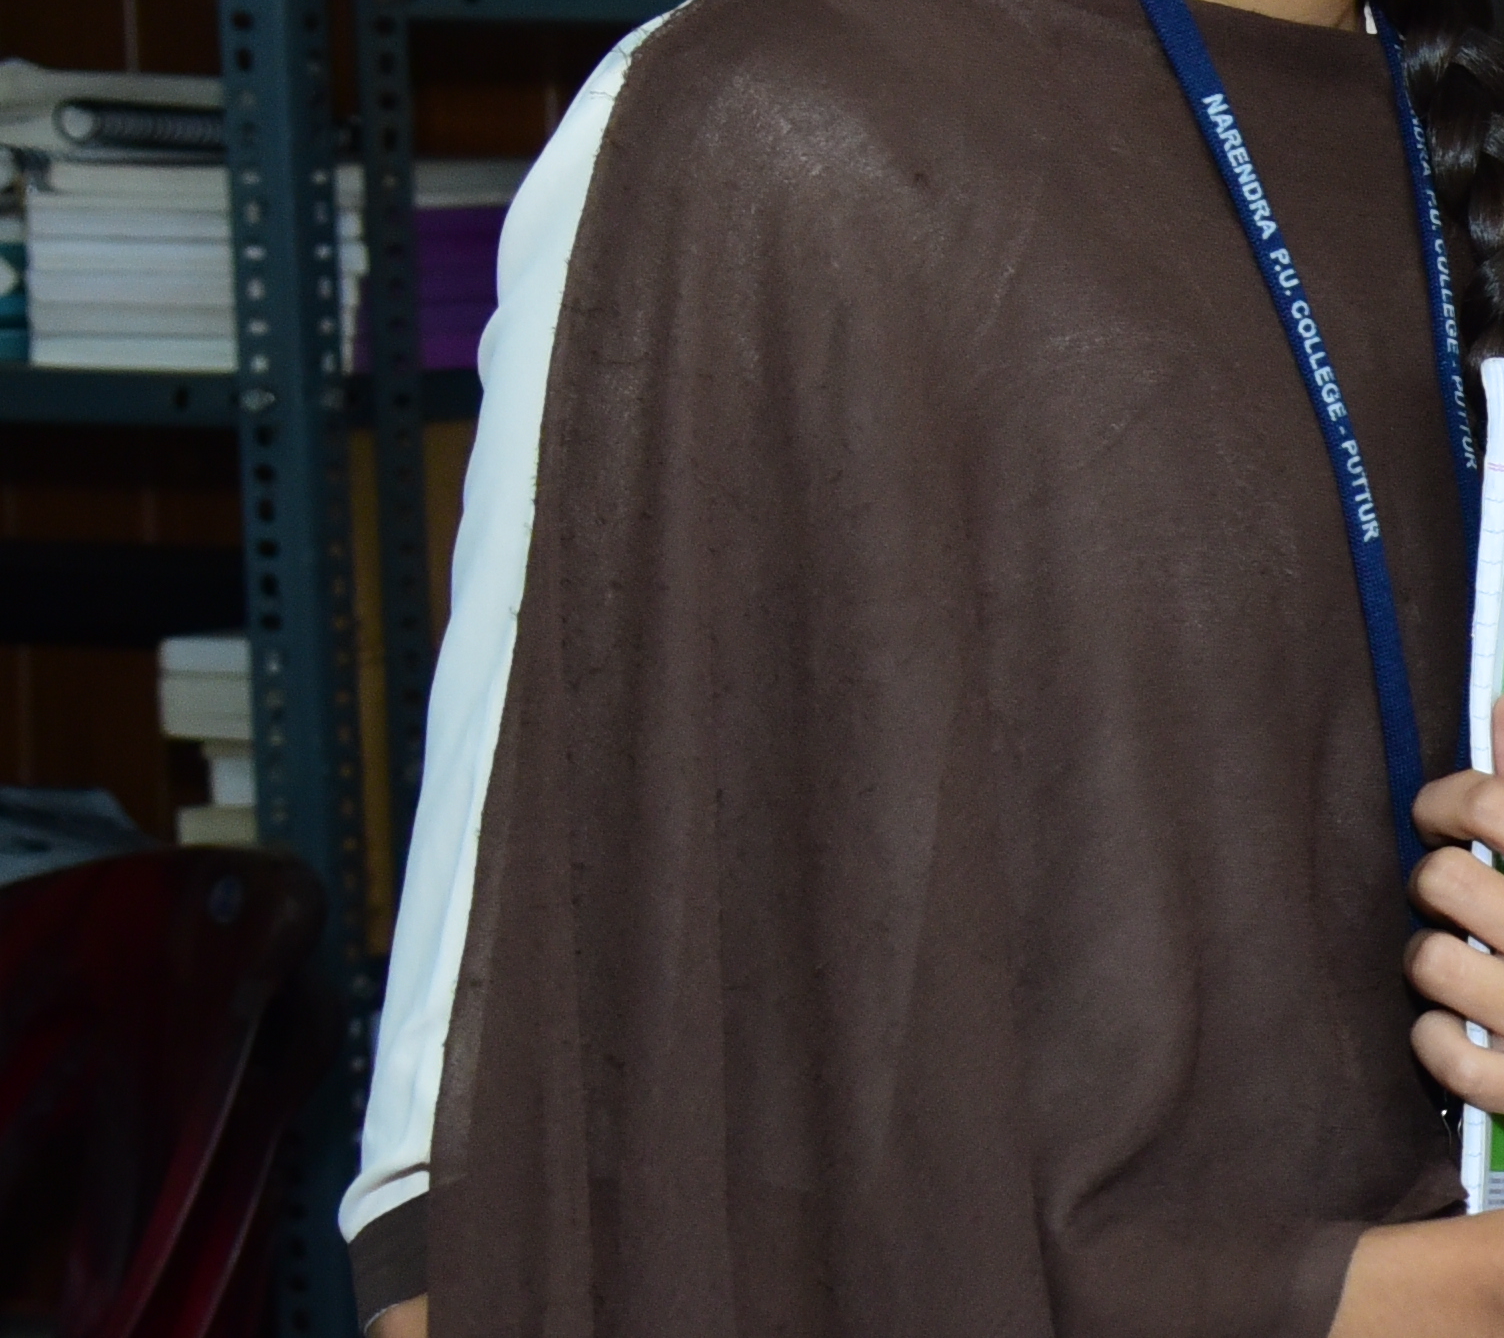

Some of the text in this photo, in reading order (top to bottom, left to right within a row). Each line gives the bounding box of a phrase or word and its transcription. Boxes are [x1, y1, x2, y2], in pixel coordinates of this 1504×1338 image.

[1202, 93, 1381, 543] NARENDRA P.U. COLLEGE PUTTUR
